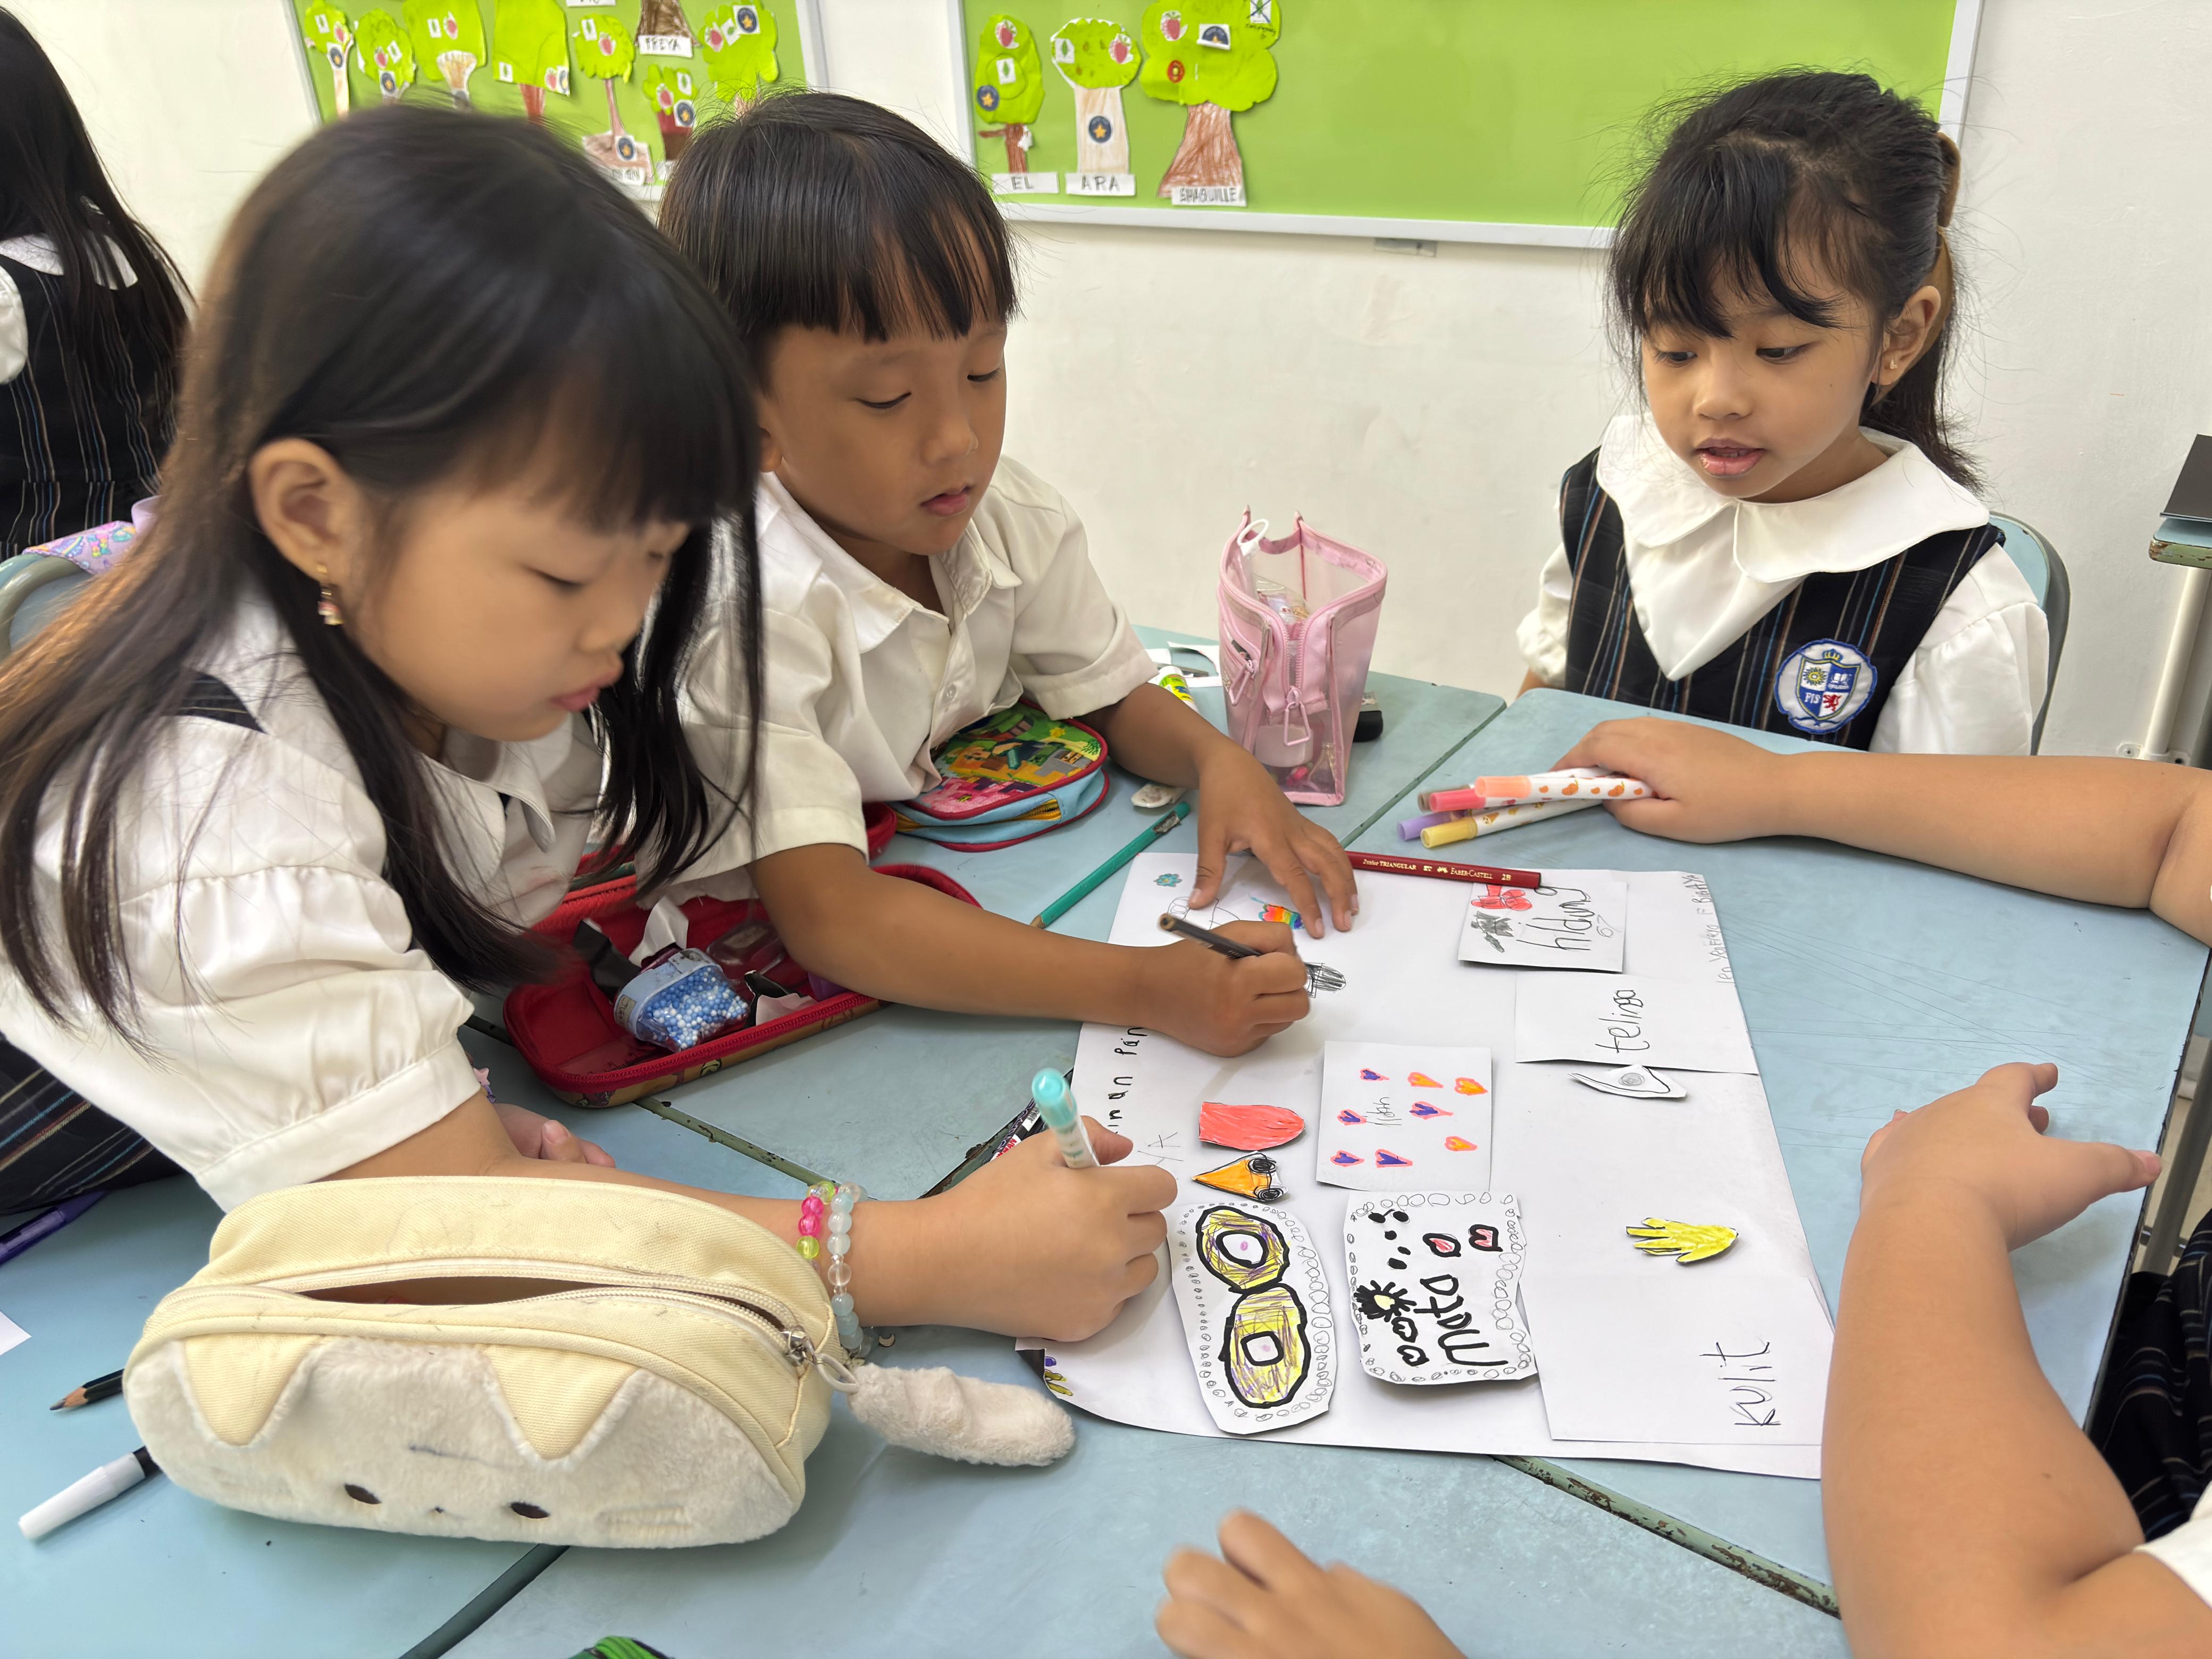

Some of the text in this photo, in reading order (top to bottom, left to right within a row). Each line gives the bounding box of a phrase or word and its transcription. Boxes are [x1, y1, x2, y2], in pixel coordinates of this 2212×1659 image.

[1011, 176, 1034, 190] EL
[1081, 174, 1120, 192] ARA
[1379, 860, 1417, 870] TRIANGULAR
[1595, 990, 1650, 1054] telinga
[1114, 1027, 1148, 1055] Pan
